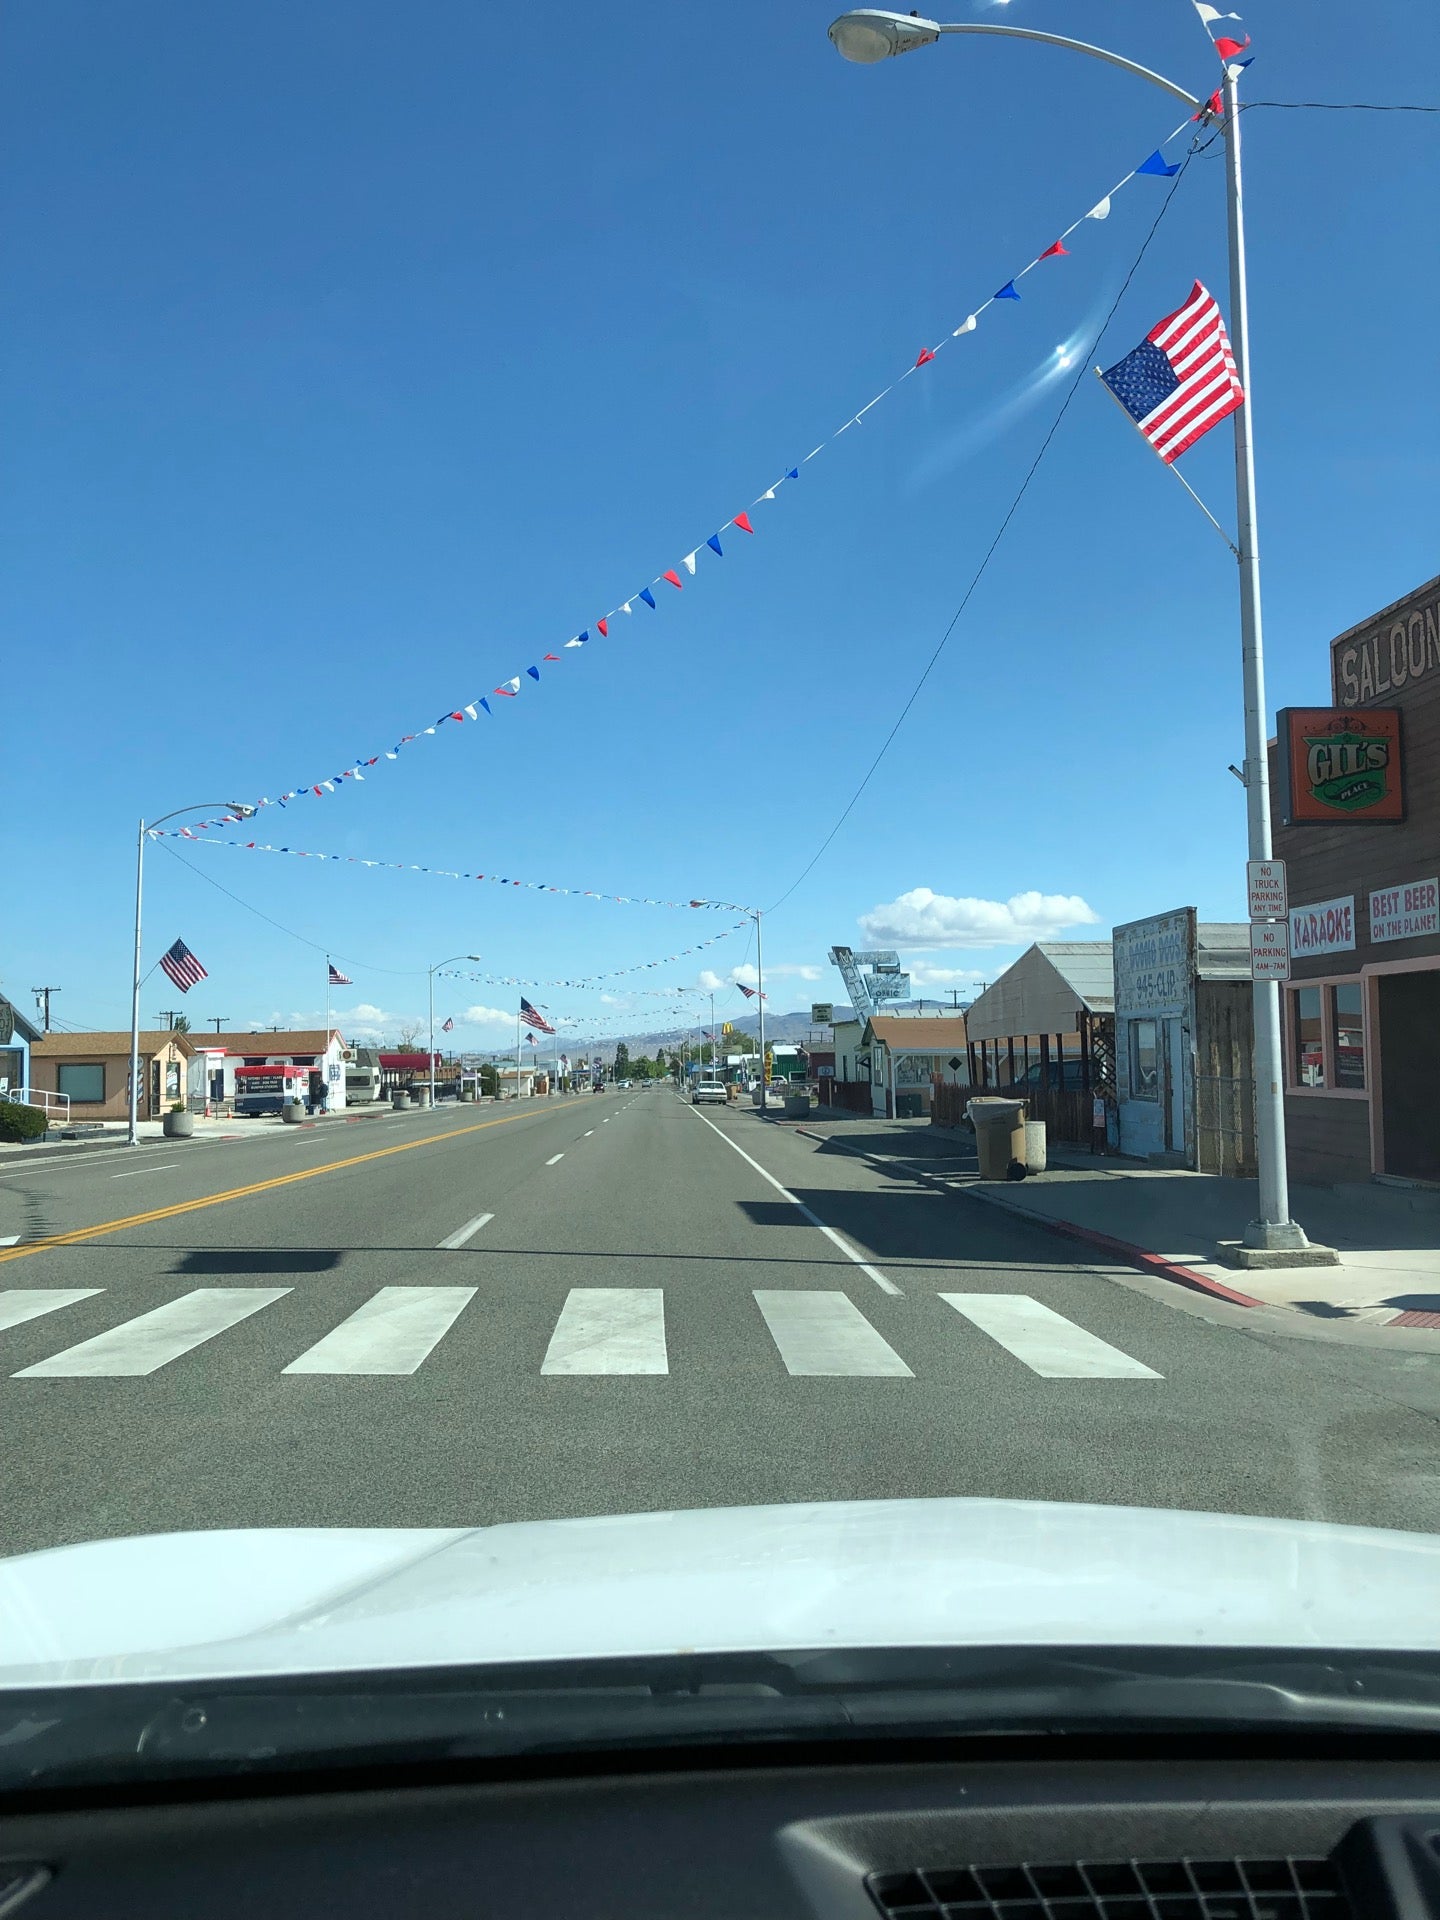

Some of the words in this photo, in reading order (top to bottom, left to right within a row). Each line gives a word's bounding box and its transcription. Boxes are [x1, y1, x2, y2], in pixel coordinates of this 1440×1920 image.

[1341, 602, 1440, 706] SALOON
[1307, 743, 1389, 786] GIL'S
[1340, 781, 1371, 801] PLACE
[1260, 867, 1272, 877] NO
[1254, 879, 1280, 889] TRUCK
[1251, 892, 1284, 901] PARKING
[1372, 891, 1400, 919] BEST
[1404, 884, 1436, 912] BEER
[1253, 904, 1266, 912] ANY
[1268, 904, 1283, 912] TIME
[1293, 906, 1352, 950] KARAOKE
[1373, 922, 1385, 938] ON
[1386, 920, 1402, 936] THE
[1404, 913, 1437, 934] PLANET
[1263, 933, 1275, 943] NO
[1253, 947, 1286, 957] PARKING
[1255, 962, 1286, 970] 4AM-7AM
